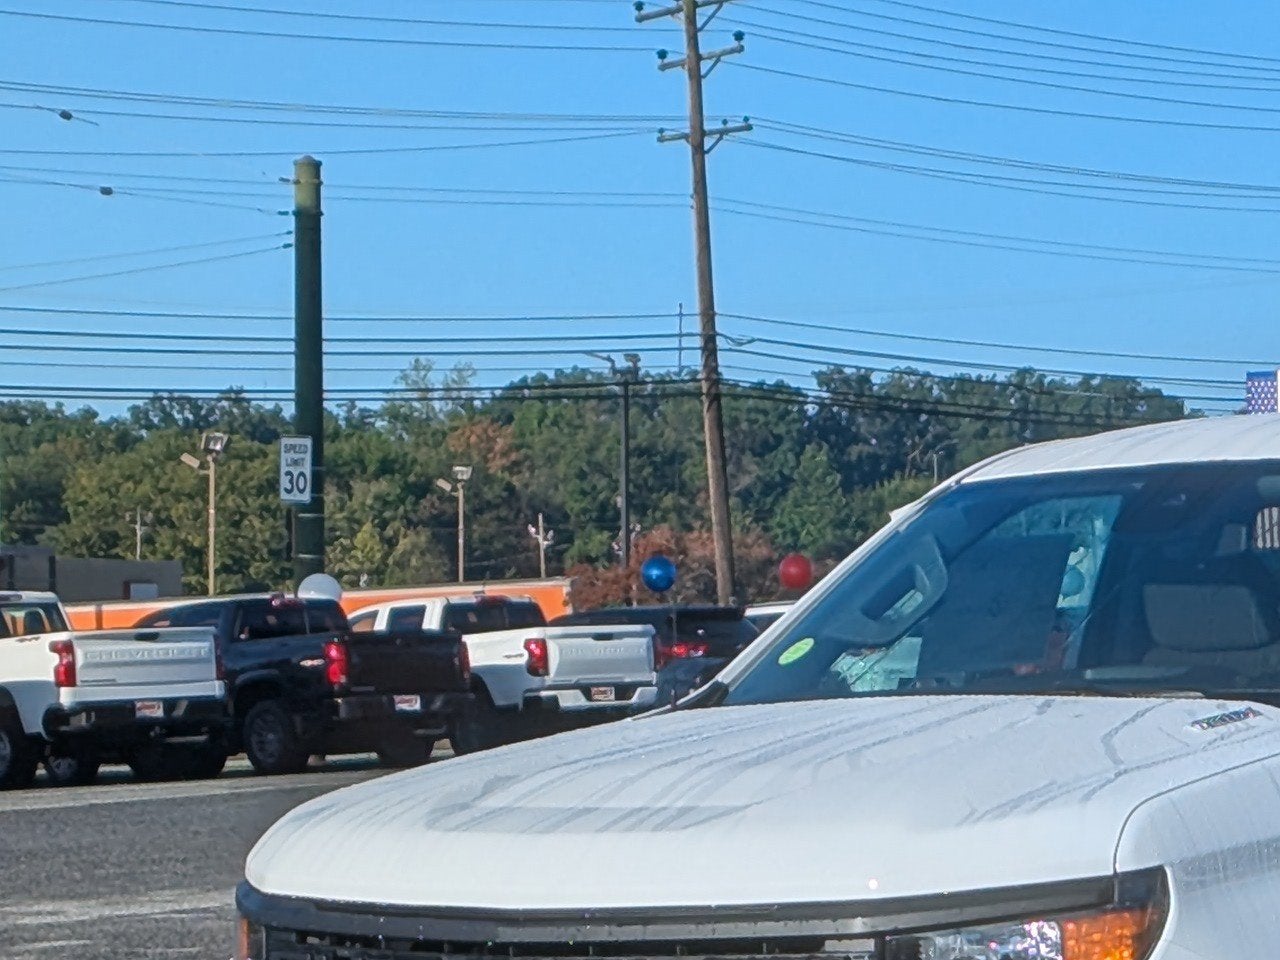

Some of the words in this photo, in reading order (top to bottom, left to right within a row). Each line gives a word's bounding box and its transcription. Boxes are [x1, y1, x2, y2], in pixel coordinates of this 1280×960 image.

[283, 443, 308, 454] SPEED
[285, 457, 306, 467] LIMIT
[283, 470, 308, 494] 30
